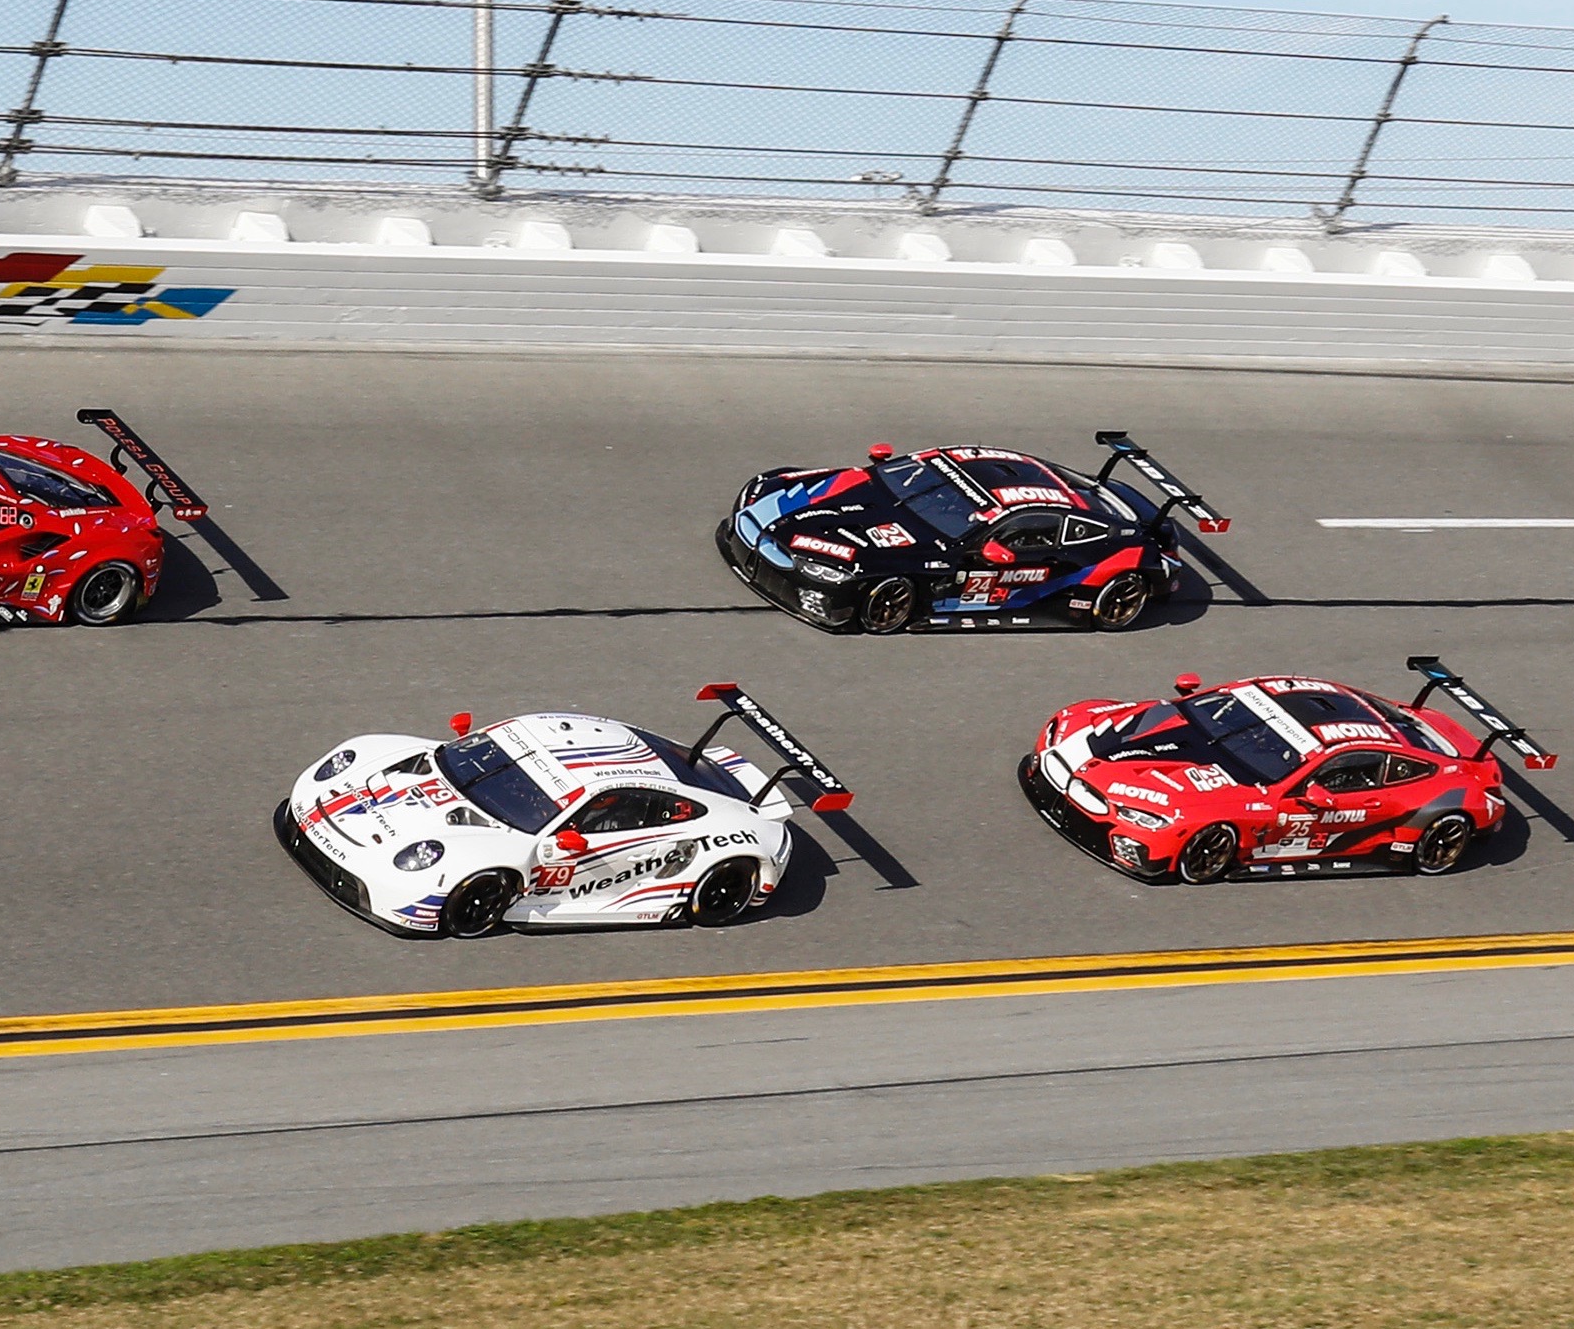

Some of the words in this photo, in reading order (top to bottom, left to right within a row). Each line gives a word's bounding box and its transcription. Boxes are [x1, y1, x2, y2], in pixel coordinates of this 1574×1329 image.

[97, 418, 147, 460] POLESA
[146, 463, 192, 505] GROUP
[930, 457, 952, 477] BMW
[948, 469, 988, 507] Motorsport
[999, 487, 1070, 504] MOTUL
[882, 525, 906, 546] 24
[794, 534, 853, 559] MOTUL
[967, 578, 991, 592] 24
[999, 569, 1046, 583] MOTUL
[1244, 691, 1266, 711] BMW
[1319, 724, 1392, 740] MOTUL
[501, 726, 570, 793] PORSCHE
[593, 768, 662, 777] WeatherTech
[1200, 767, 1228, 789] 25
[423, 781, 456, 804] 79
[1107, 782, 1170, 807] MOTUL
[1320, 810, 1367, 823] MOTUL
[1286, 822, 1311, 837] 25
[543, 865, 571, 887] 79
[568, 831, 757, 900] WeatheTech
[636, 913, 660, 921] GTLM
